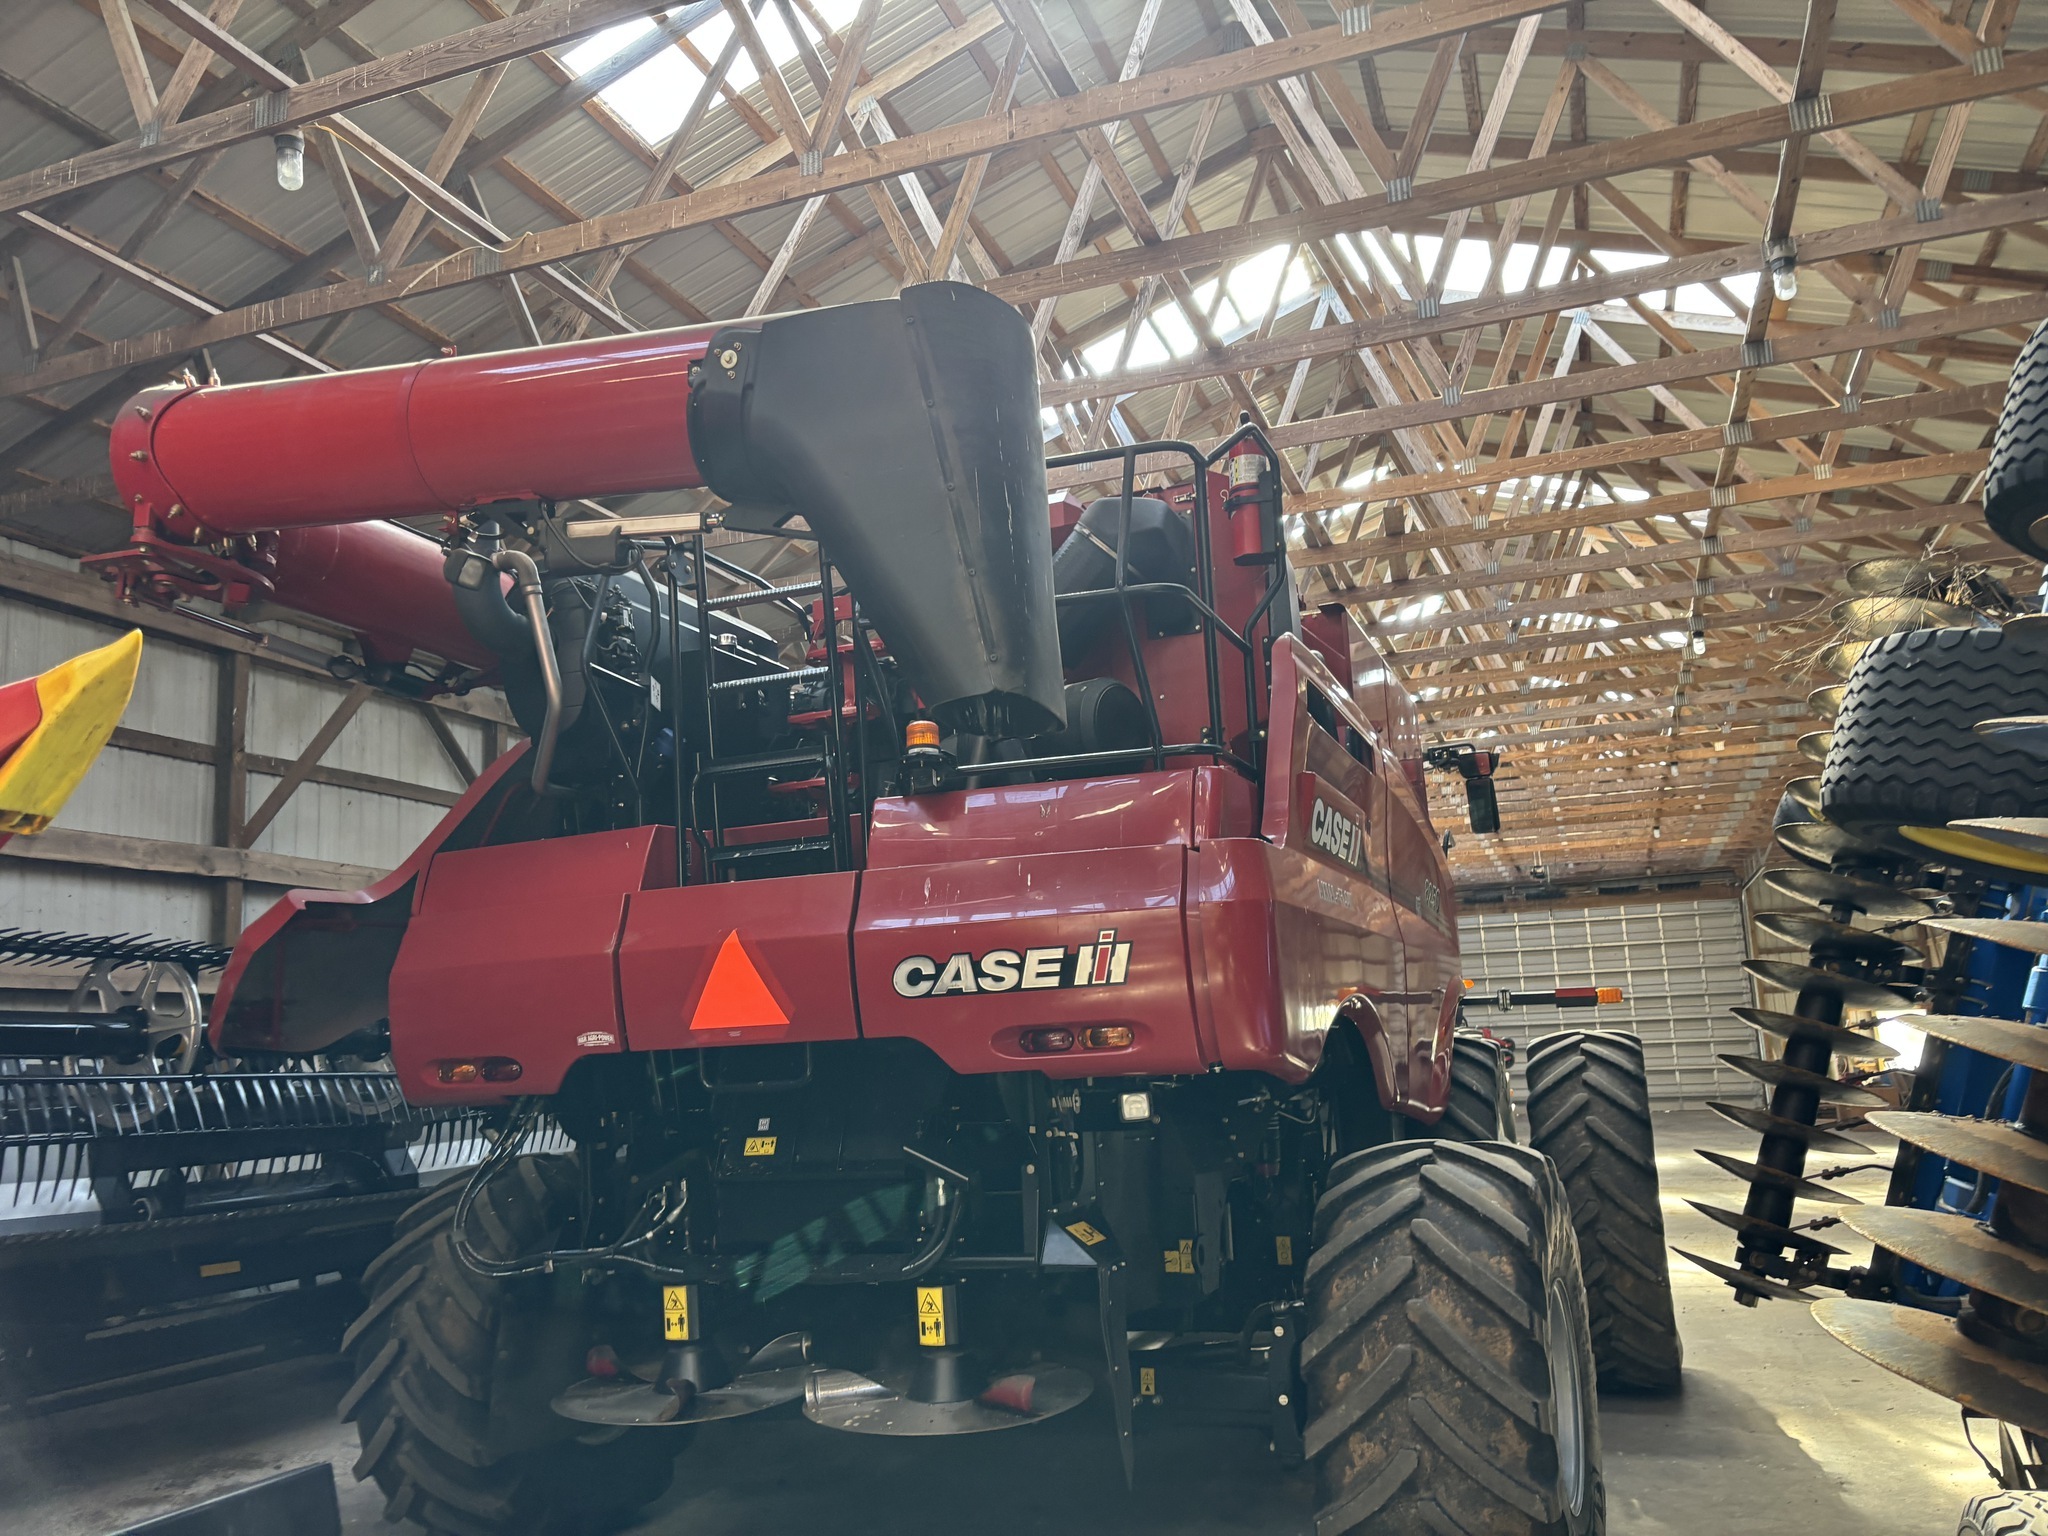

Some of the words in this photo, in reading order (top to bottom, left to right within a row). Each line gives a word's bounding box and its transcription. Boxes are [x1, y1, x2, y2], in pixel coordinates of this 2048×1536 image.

[1311, 797, 1350, 860] CASE
[892, 946, 1067, 998] CASE
[1073, 928, 1133, 986] IH
